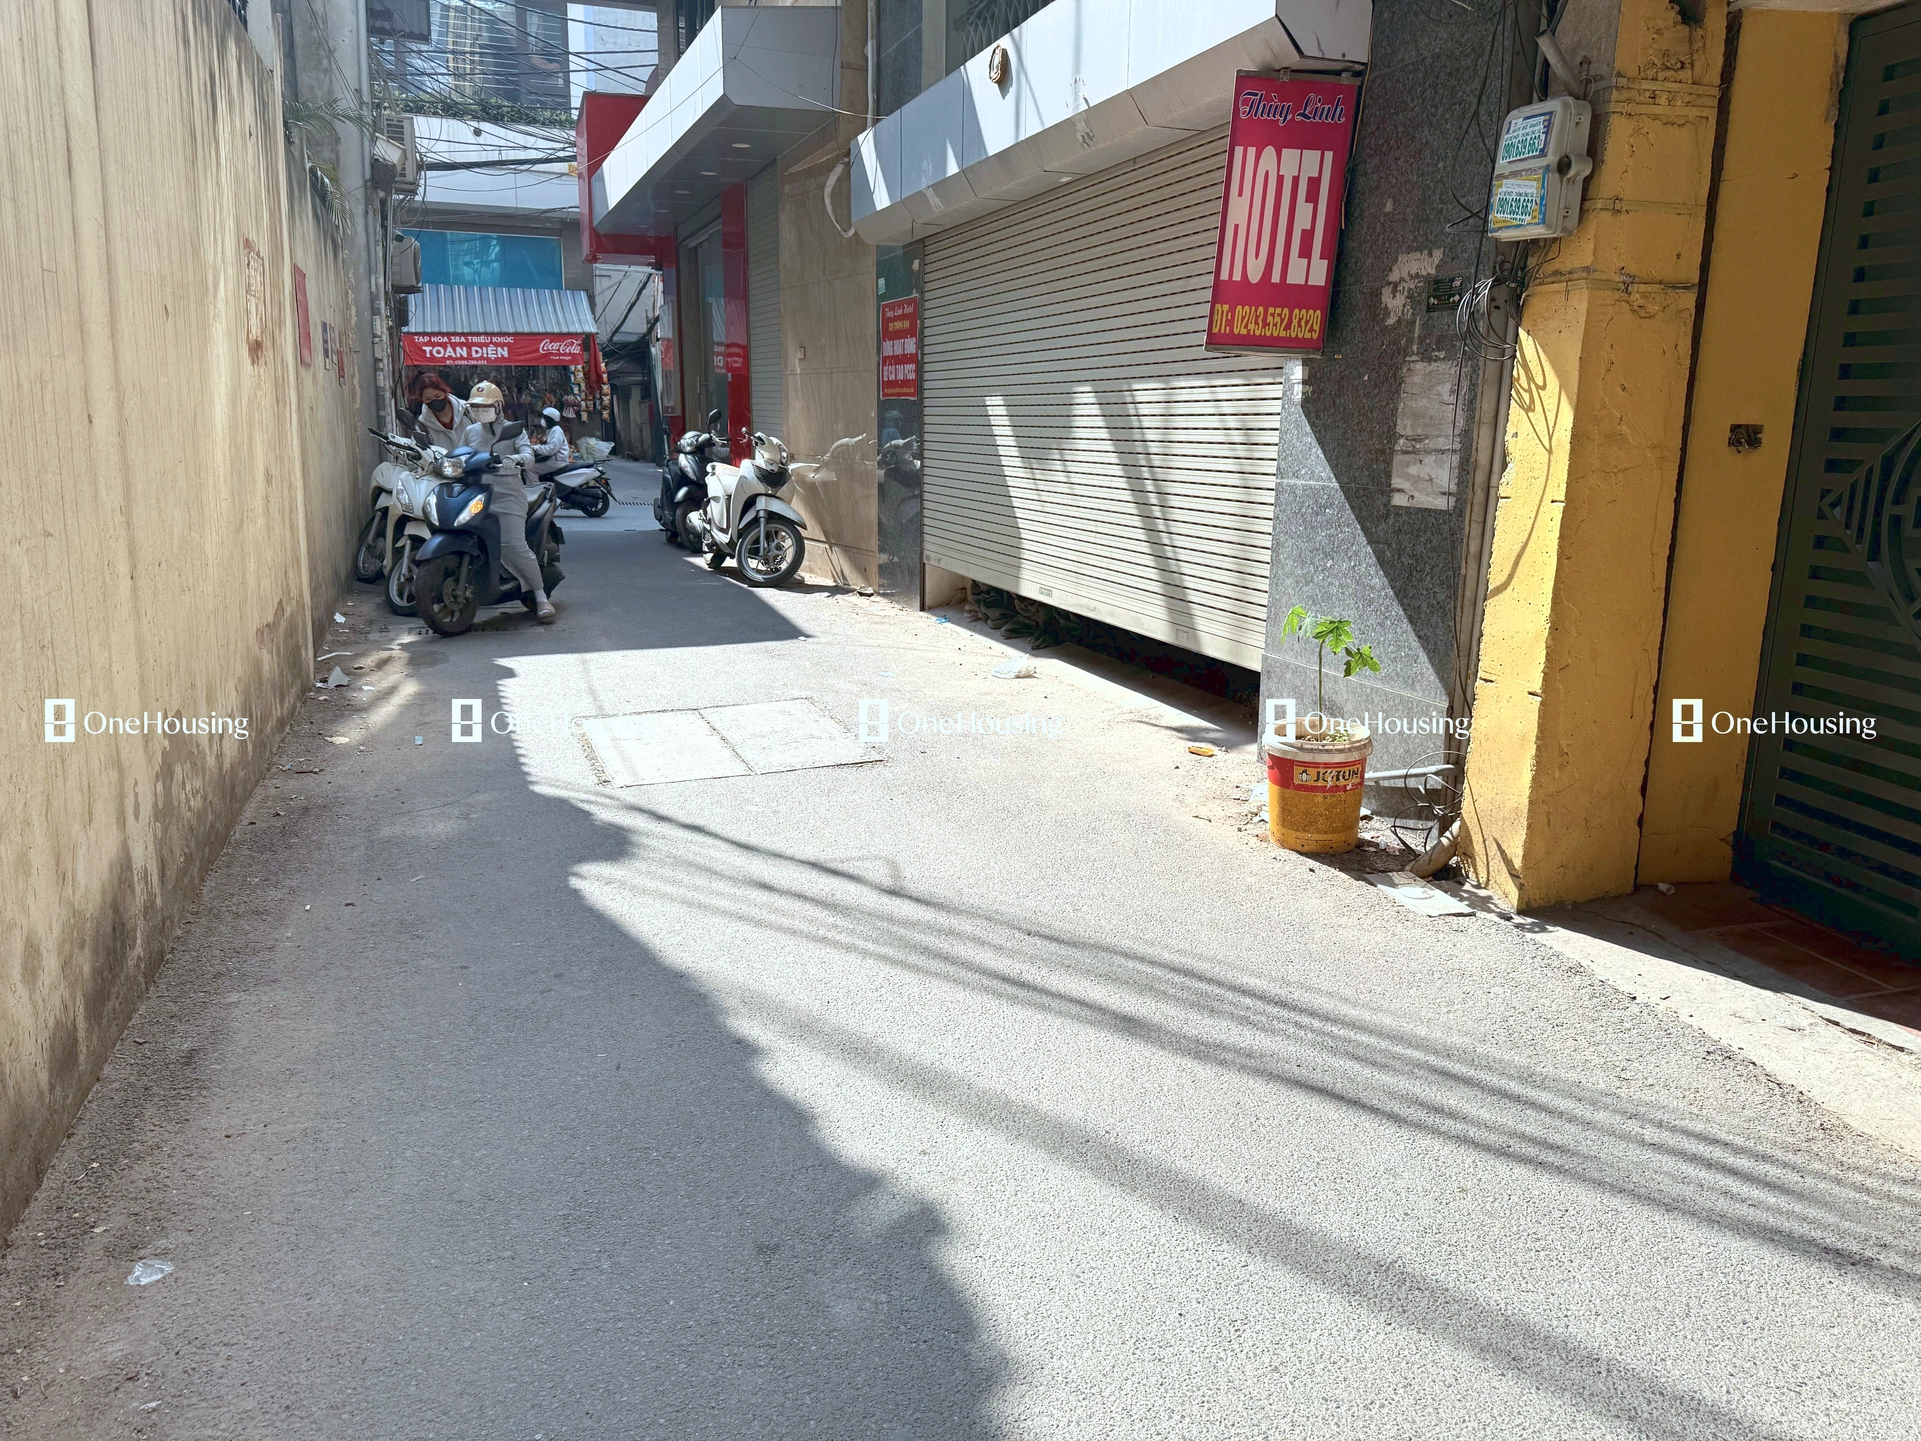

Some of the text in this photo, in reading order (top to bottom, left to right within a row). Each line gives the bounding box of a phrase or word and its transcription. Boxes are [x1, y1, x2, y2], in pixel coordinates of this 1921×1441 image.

[1239, 90, 1346, 126] Thùy Linh
[1220, 145, 1334, 286] HOTEL
[1212, 303, 1321, 340] ĐT: 0243.552.8329
[414, 335, 430, 345] TẠP
[450, 335, 466, 343] 38A
[422, 344, 509, 360] TOÀN DIỆN
[539, 339, 582, 354] Coca-Cola
